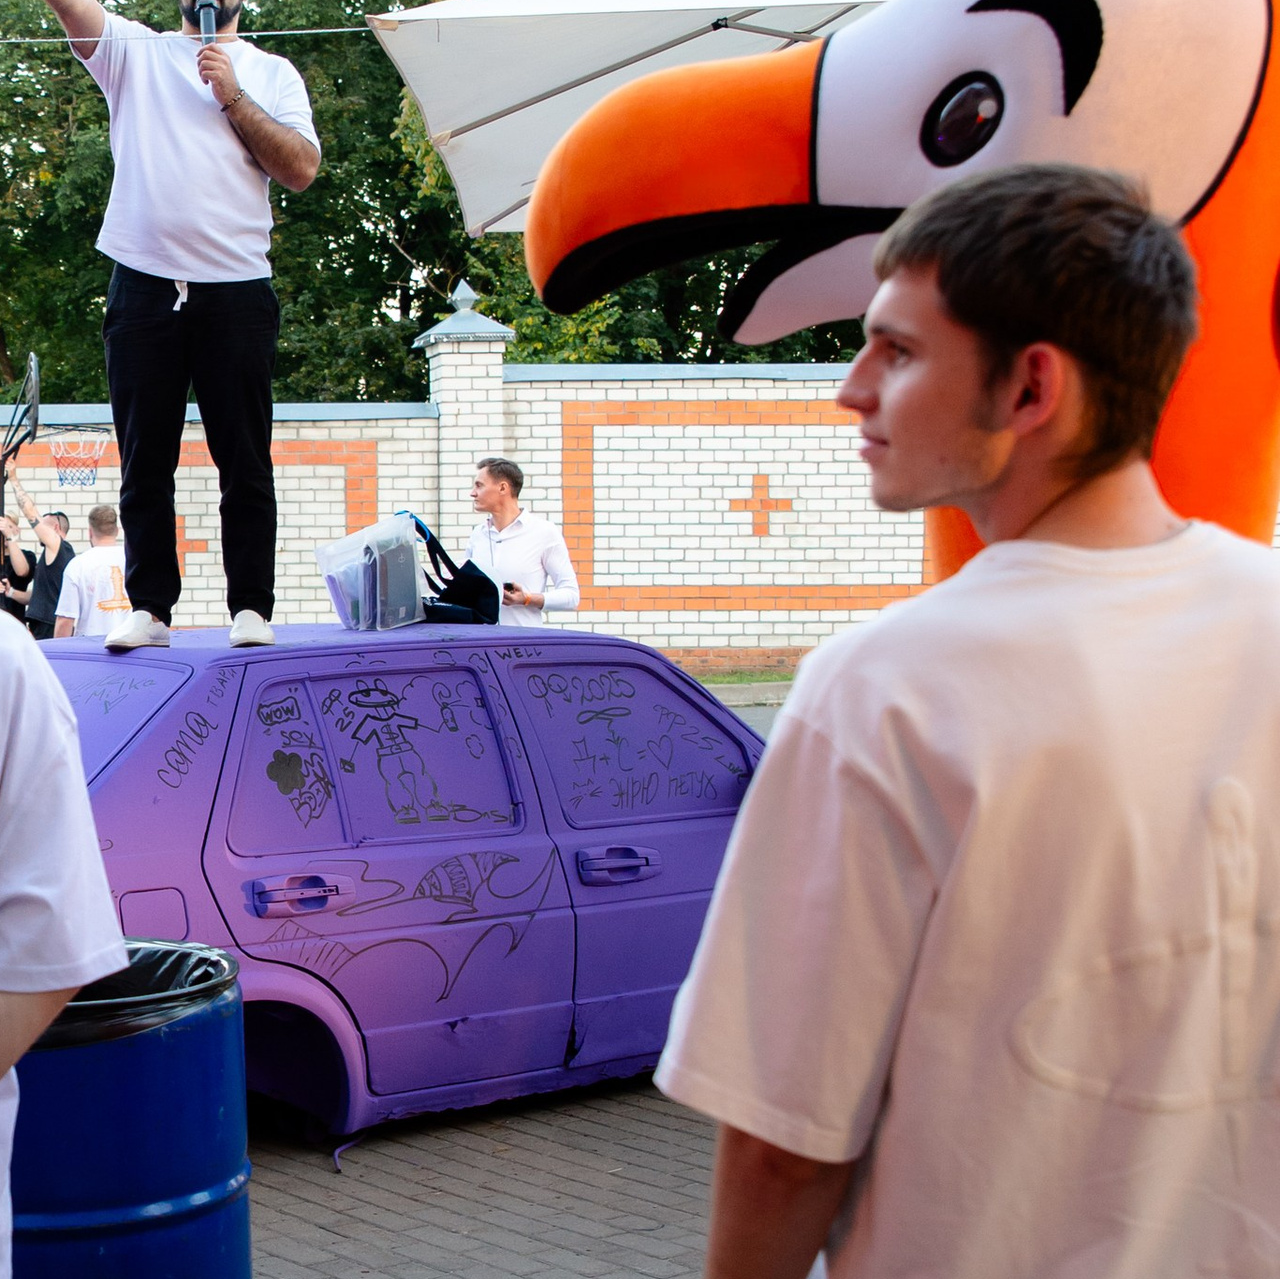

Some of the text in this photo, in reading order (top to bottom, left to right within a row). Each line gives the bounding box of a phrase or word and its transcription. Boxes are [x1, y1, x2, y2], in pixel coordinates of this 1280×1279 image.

[494, 647, 543, 660] WELL
[571, 670, 636, 706] 2025
[260, 703, 296, 723] WOW
[667, 770, 718, 801] ПЕТУХ
